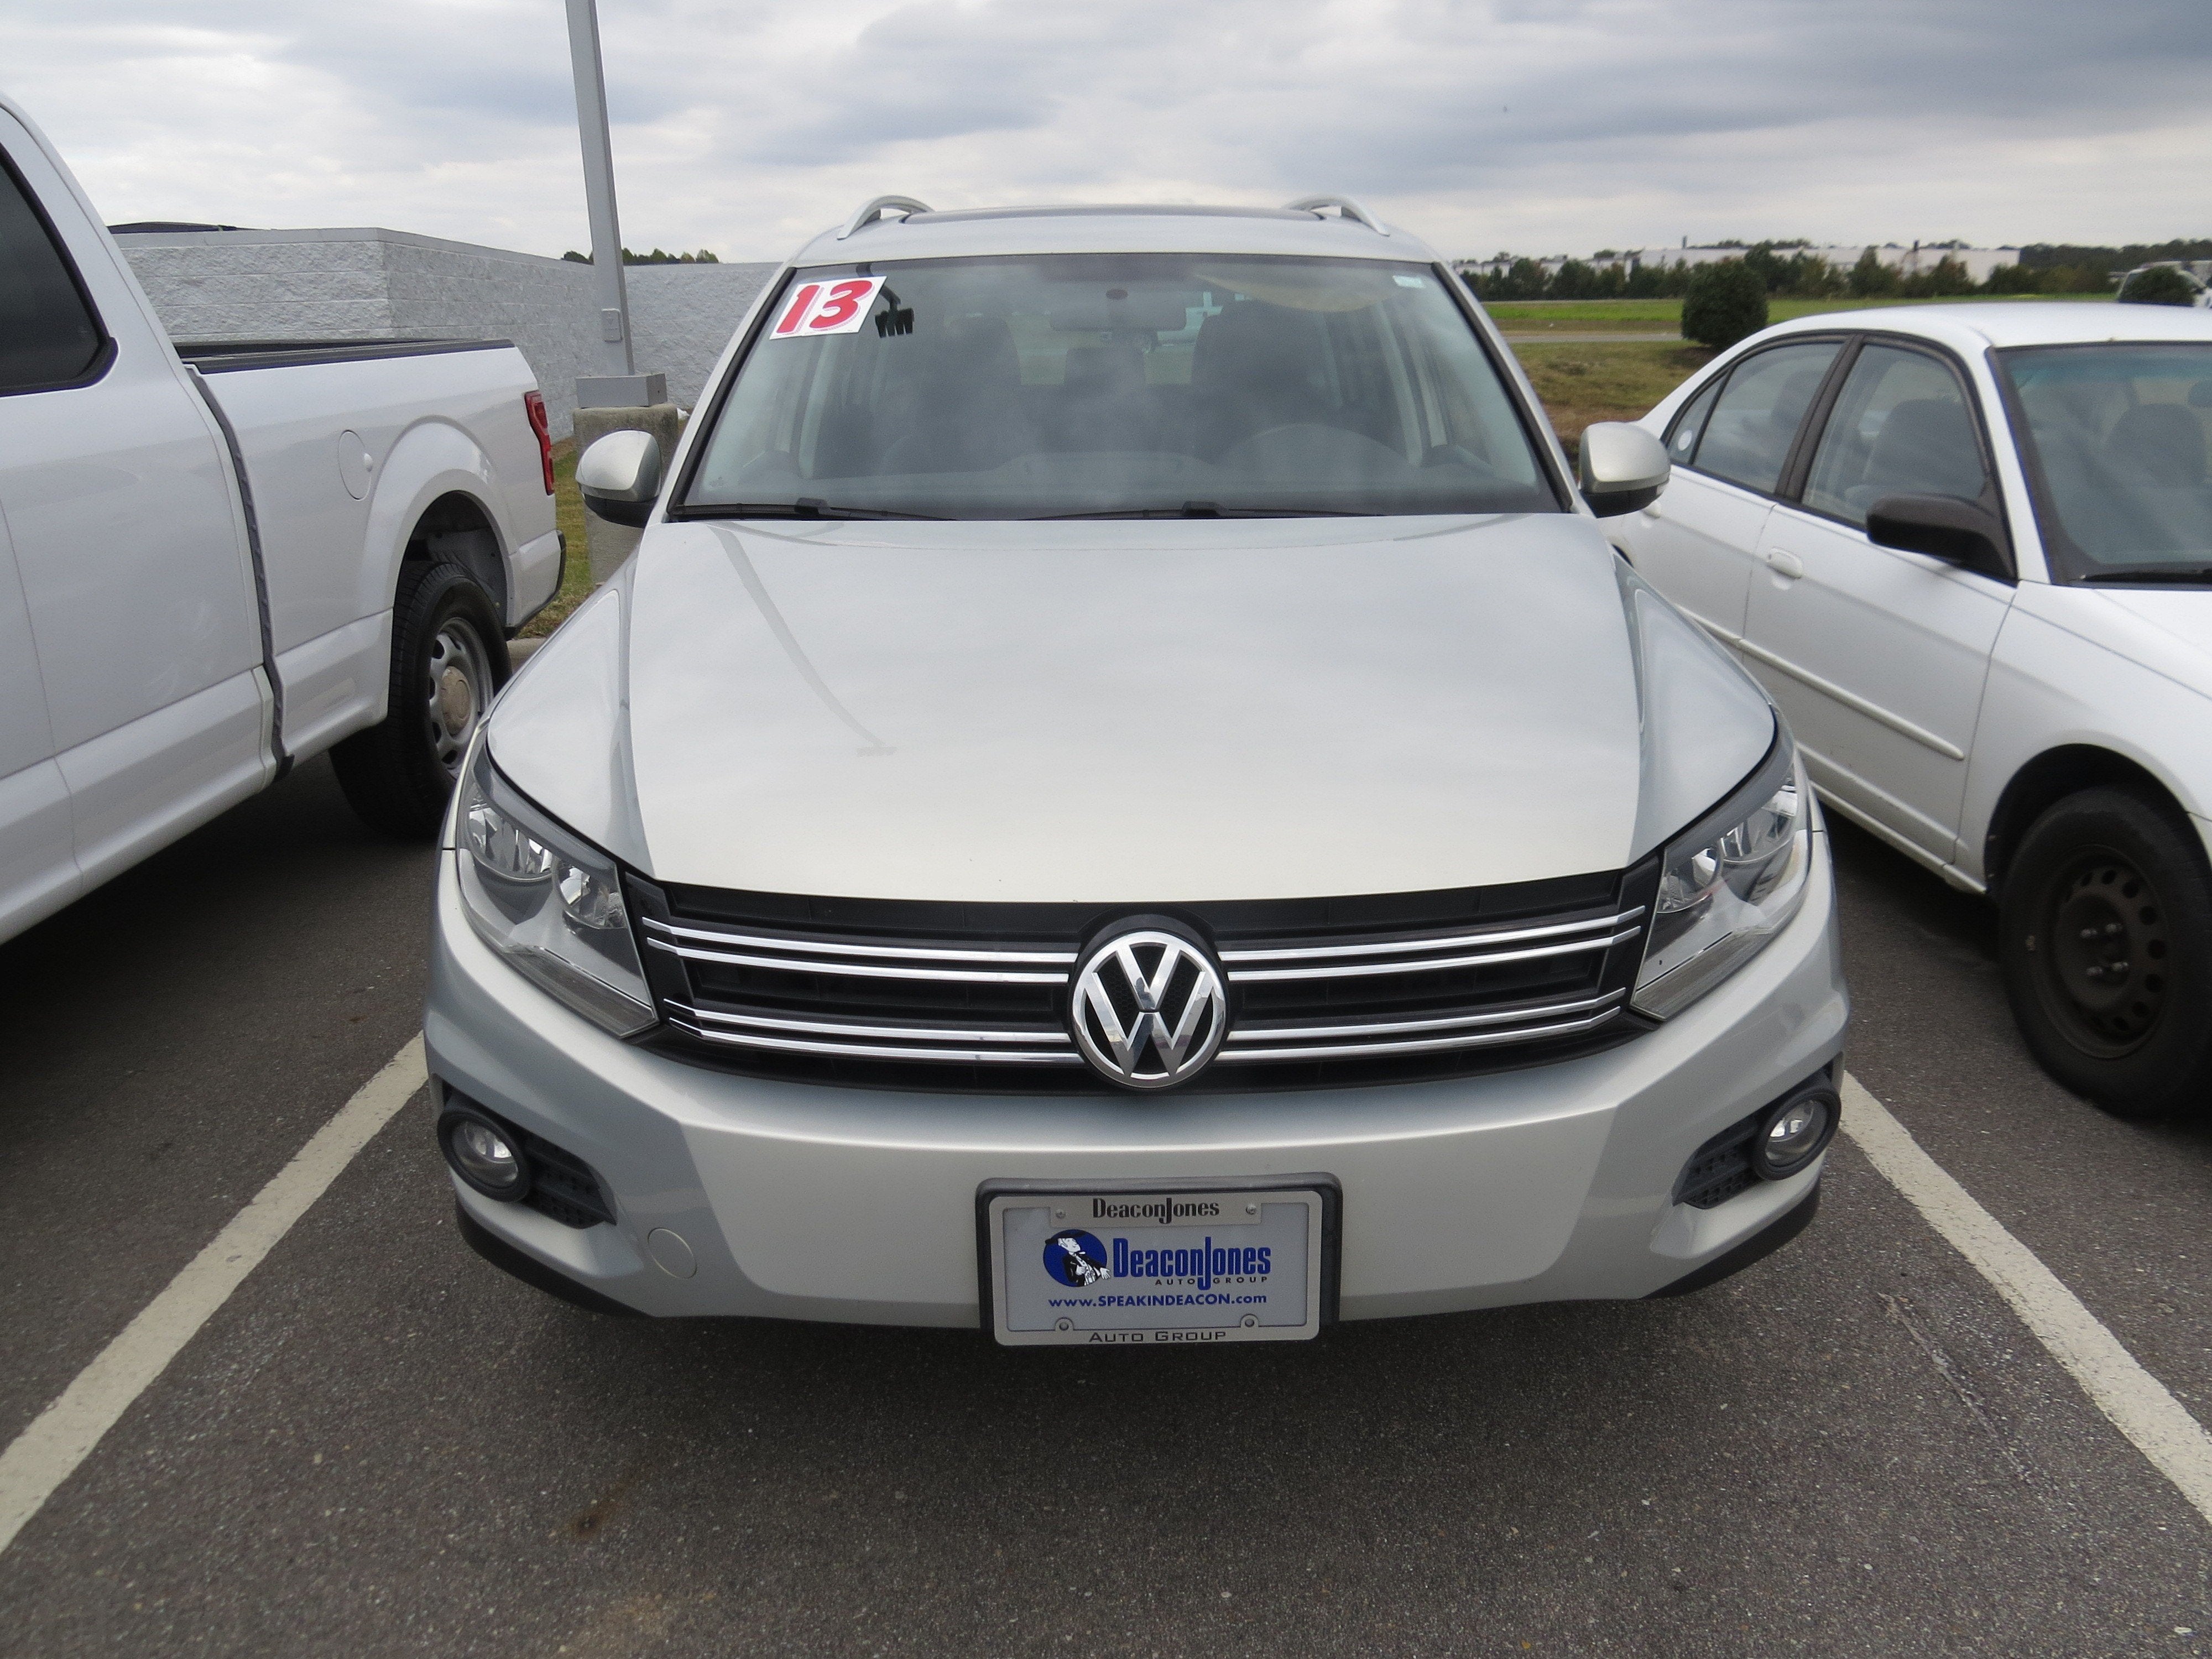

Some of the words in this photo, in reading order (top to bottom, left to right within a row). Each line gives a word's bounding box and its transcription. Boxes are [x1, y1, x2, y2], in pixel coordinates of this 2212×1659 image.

[776, 280, 873, 334] 13
[1212, 1276, 1268, 1285] GROUP
[1047, 1293, 1267, 1307] www.SPEAKINDEACON.com
